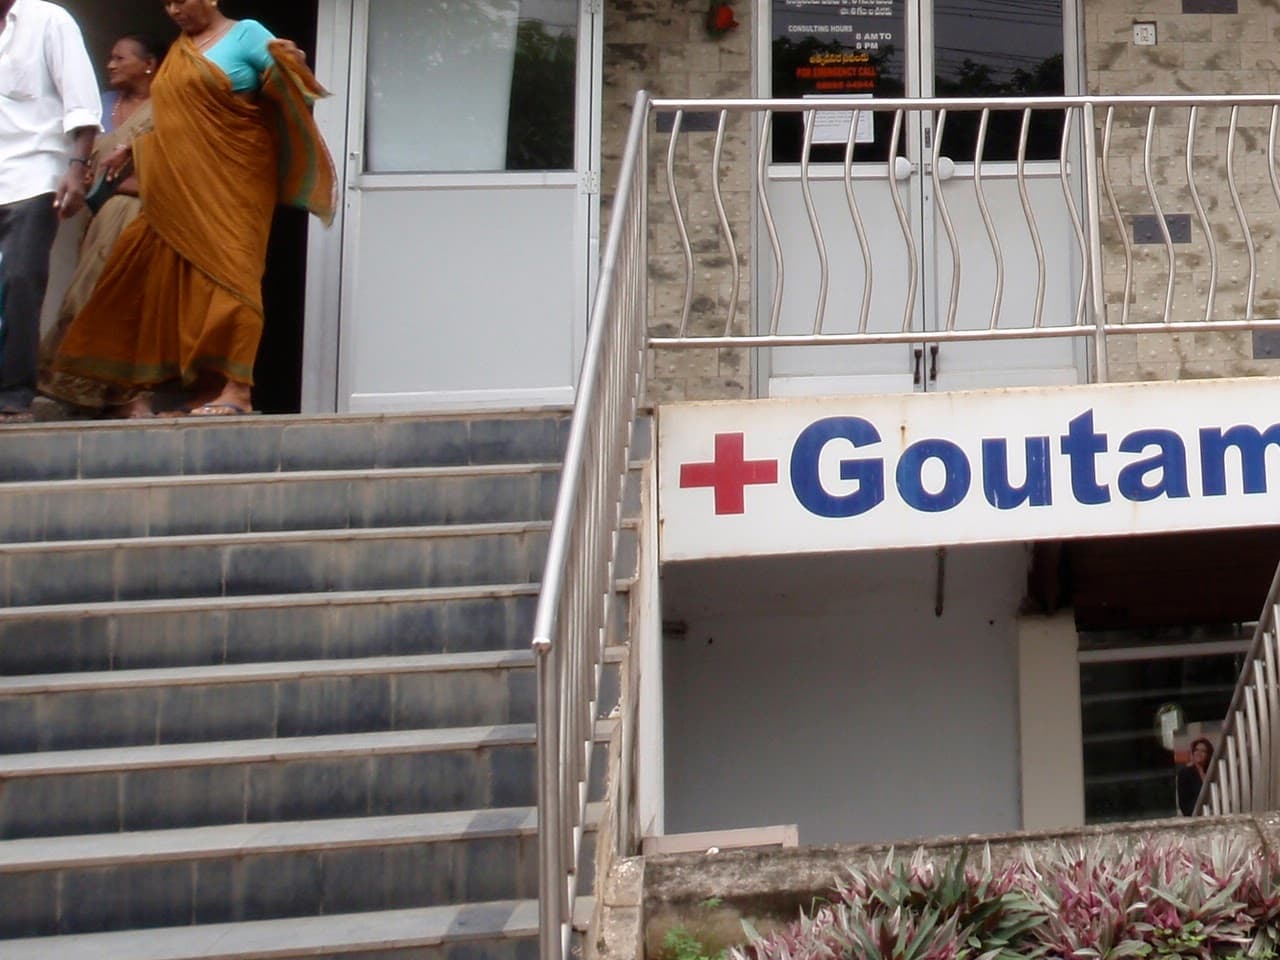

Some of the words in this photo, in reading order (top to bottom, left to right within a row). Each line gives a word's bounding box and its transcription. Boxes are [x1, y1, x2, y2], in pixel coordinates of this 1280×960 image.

[788, 25, 829, 33] CONSULTING
[830, 25, 853, 33] HOURS
[864, 42, 879, 50] PM
